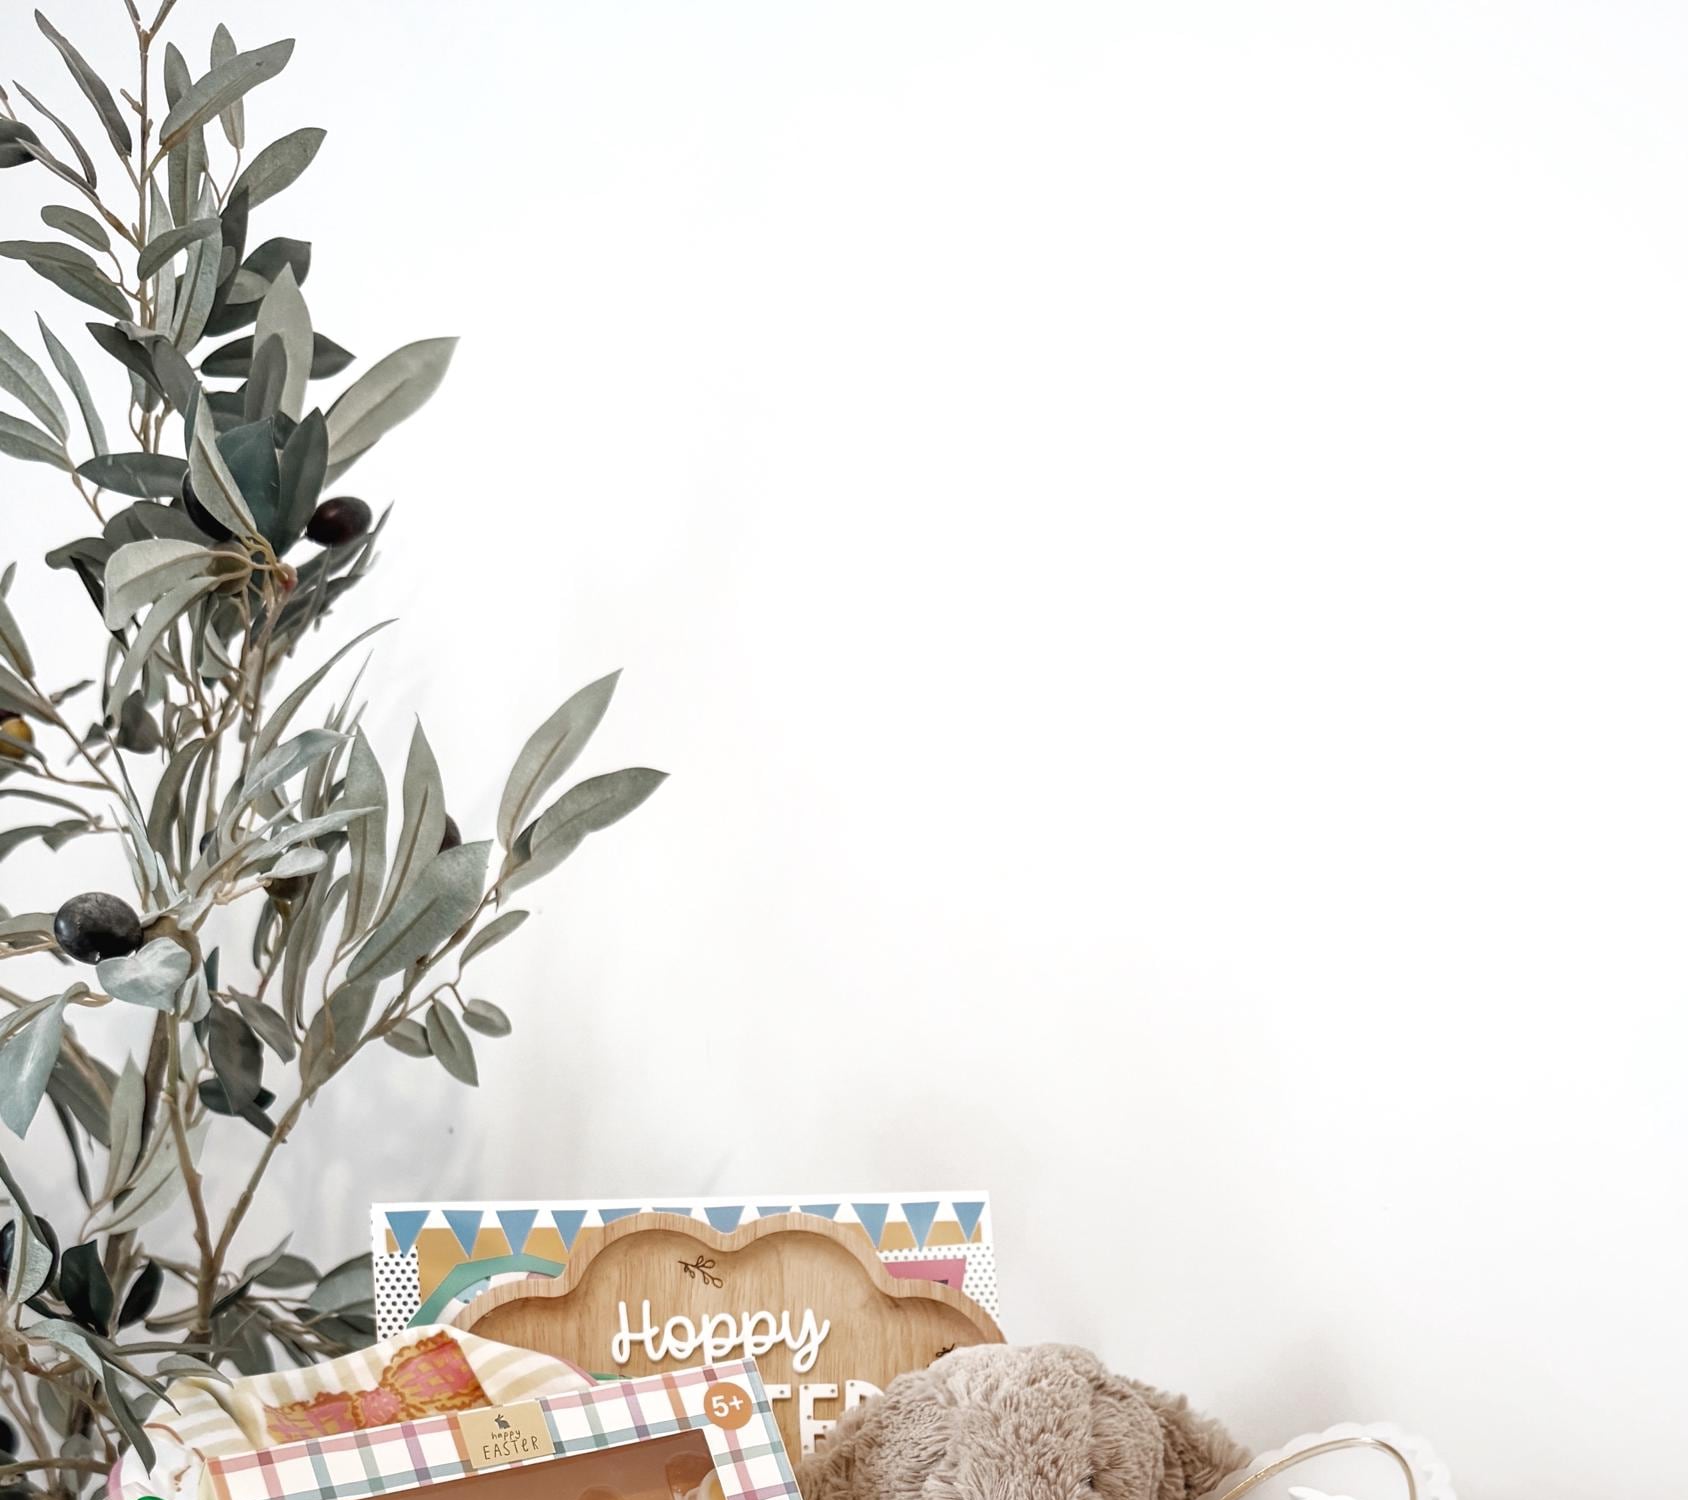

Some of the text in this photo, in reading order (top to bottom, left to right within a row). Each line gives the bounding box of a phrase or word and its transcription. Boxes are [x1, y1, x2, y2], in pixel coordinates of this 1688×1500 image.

[611, 1299, 831, 1373] Hoppy
[711, 1395, 744, 1418] 5+
[491, 1430, 521, 1441] happy
